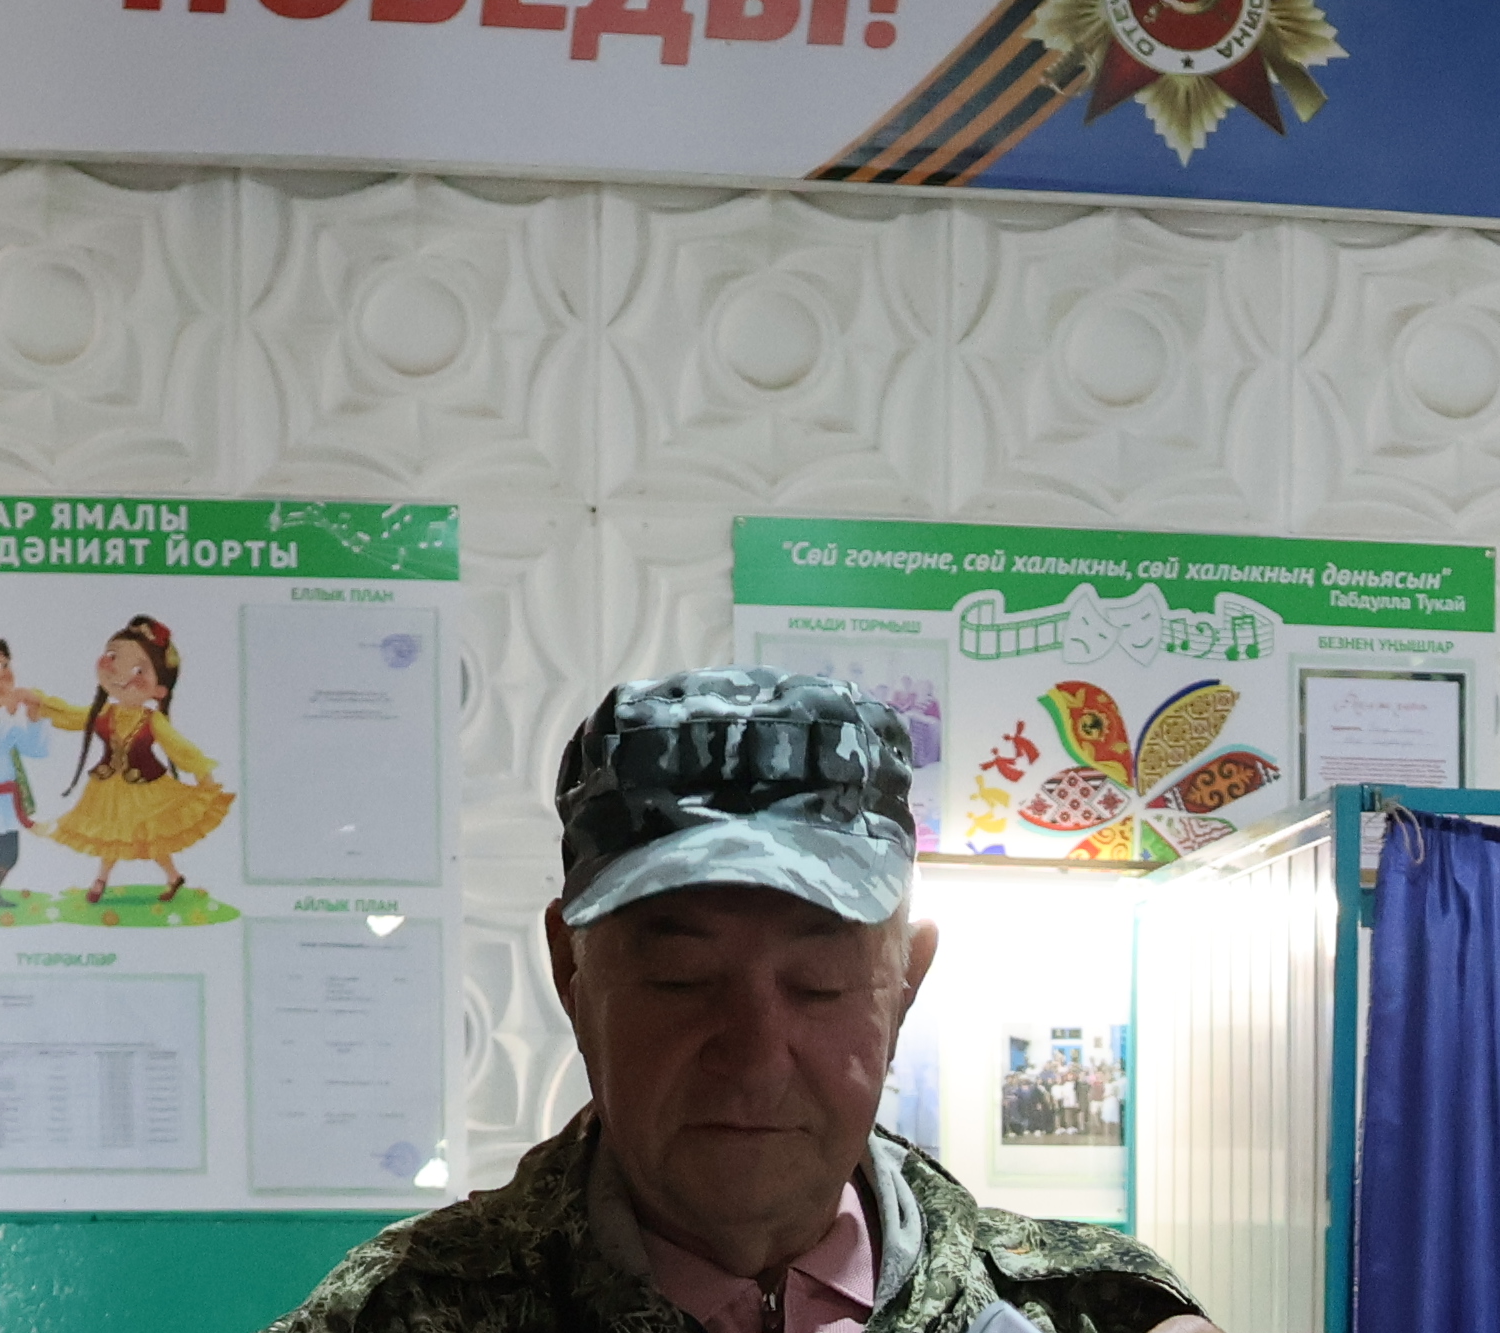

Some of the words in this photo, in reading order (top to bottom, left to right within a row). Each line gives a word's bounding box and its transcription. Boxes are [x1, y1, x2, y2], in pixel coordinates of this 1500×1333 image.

[49, 502, 189, 532] ЯМАЛЫ
[165, 531, 298, 569] ЙОРТЫ
[844, 548, 959, 575] гомерне,
[963, 549, 1006, 572] сөй
[1011, 554, 1132, 580] халыкны,
[1137, 557, 1180, 579] сөй
[1185, 561, 1315, 587] халыкның
[1329, 590, 1411, 613] Габдулла
[1415, 593, 1466, 615] Тукай
